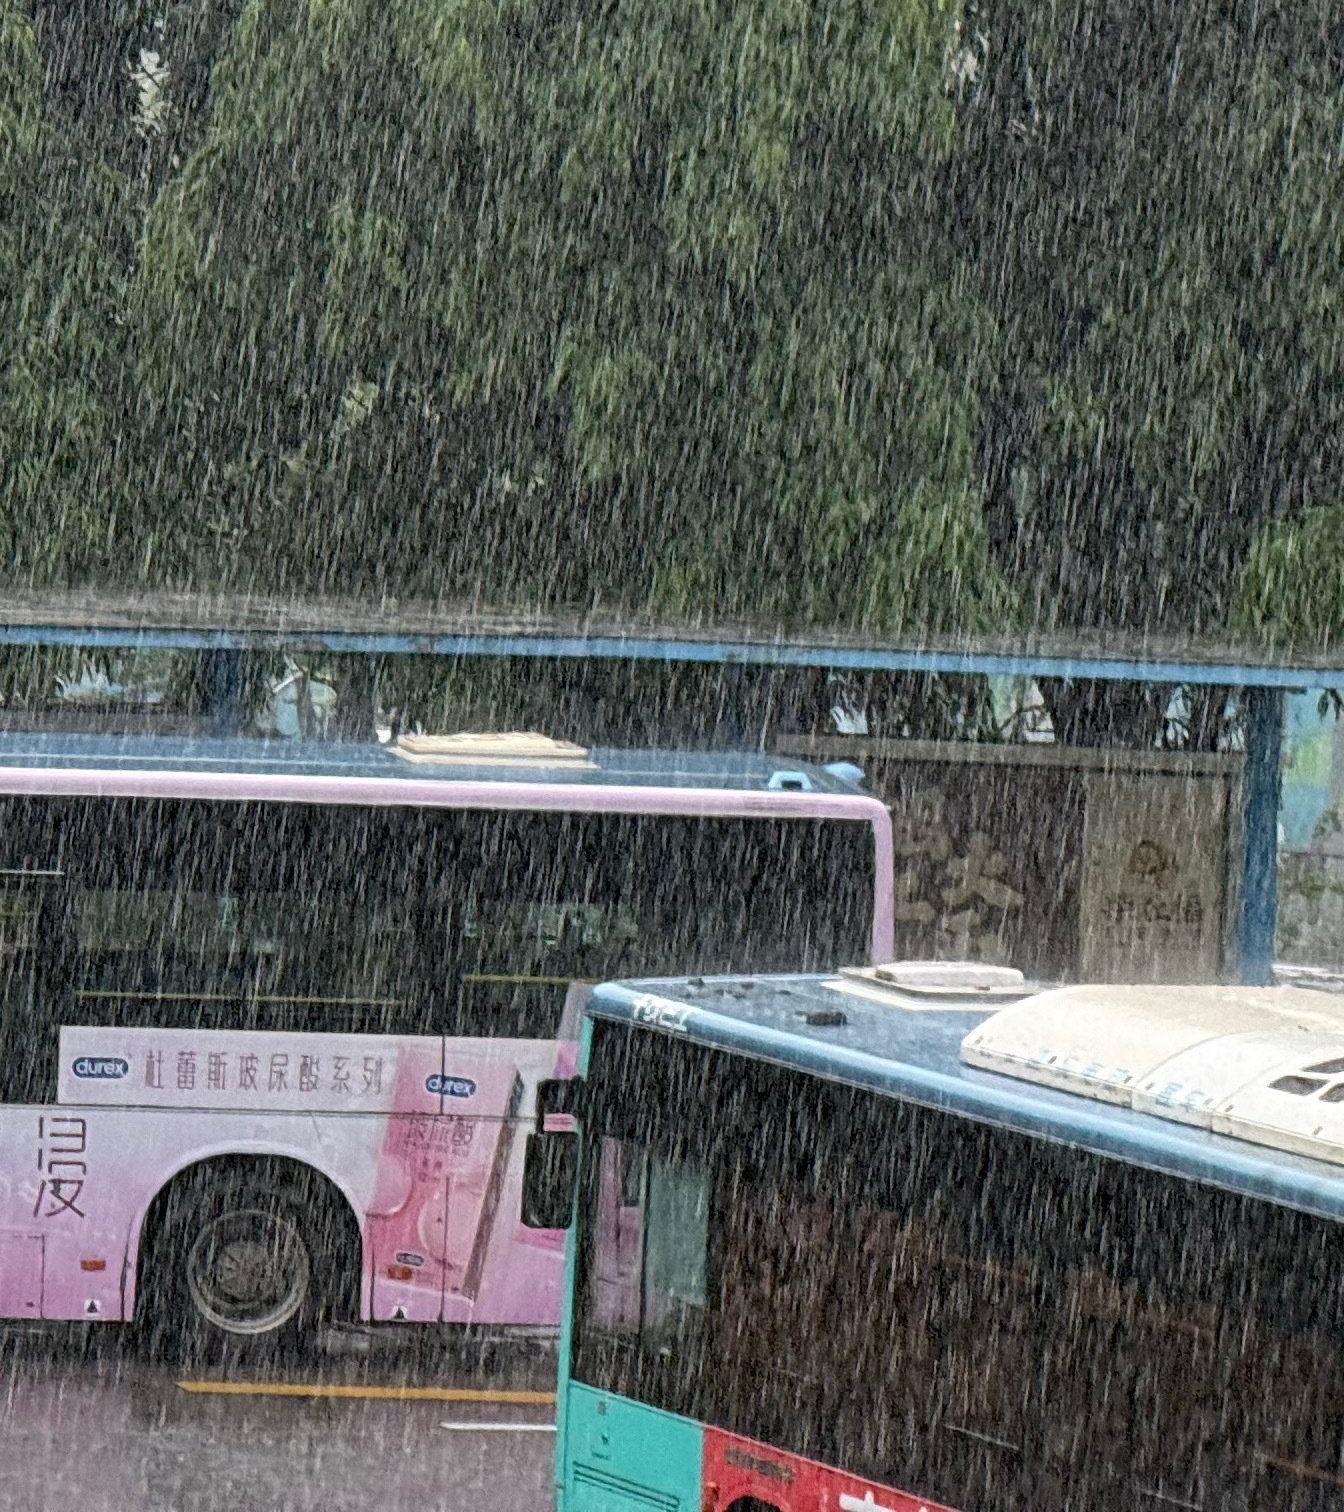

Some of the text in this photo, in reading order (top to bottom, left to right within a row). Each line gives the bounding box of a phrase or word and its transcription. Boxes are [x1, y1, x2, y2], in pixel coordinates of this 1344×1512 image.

[74, 1059, 126, 1076] durex
[145, 1050, 383, 1094] 杜蕾斯玻尿酸系列
